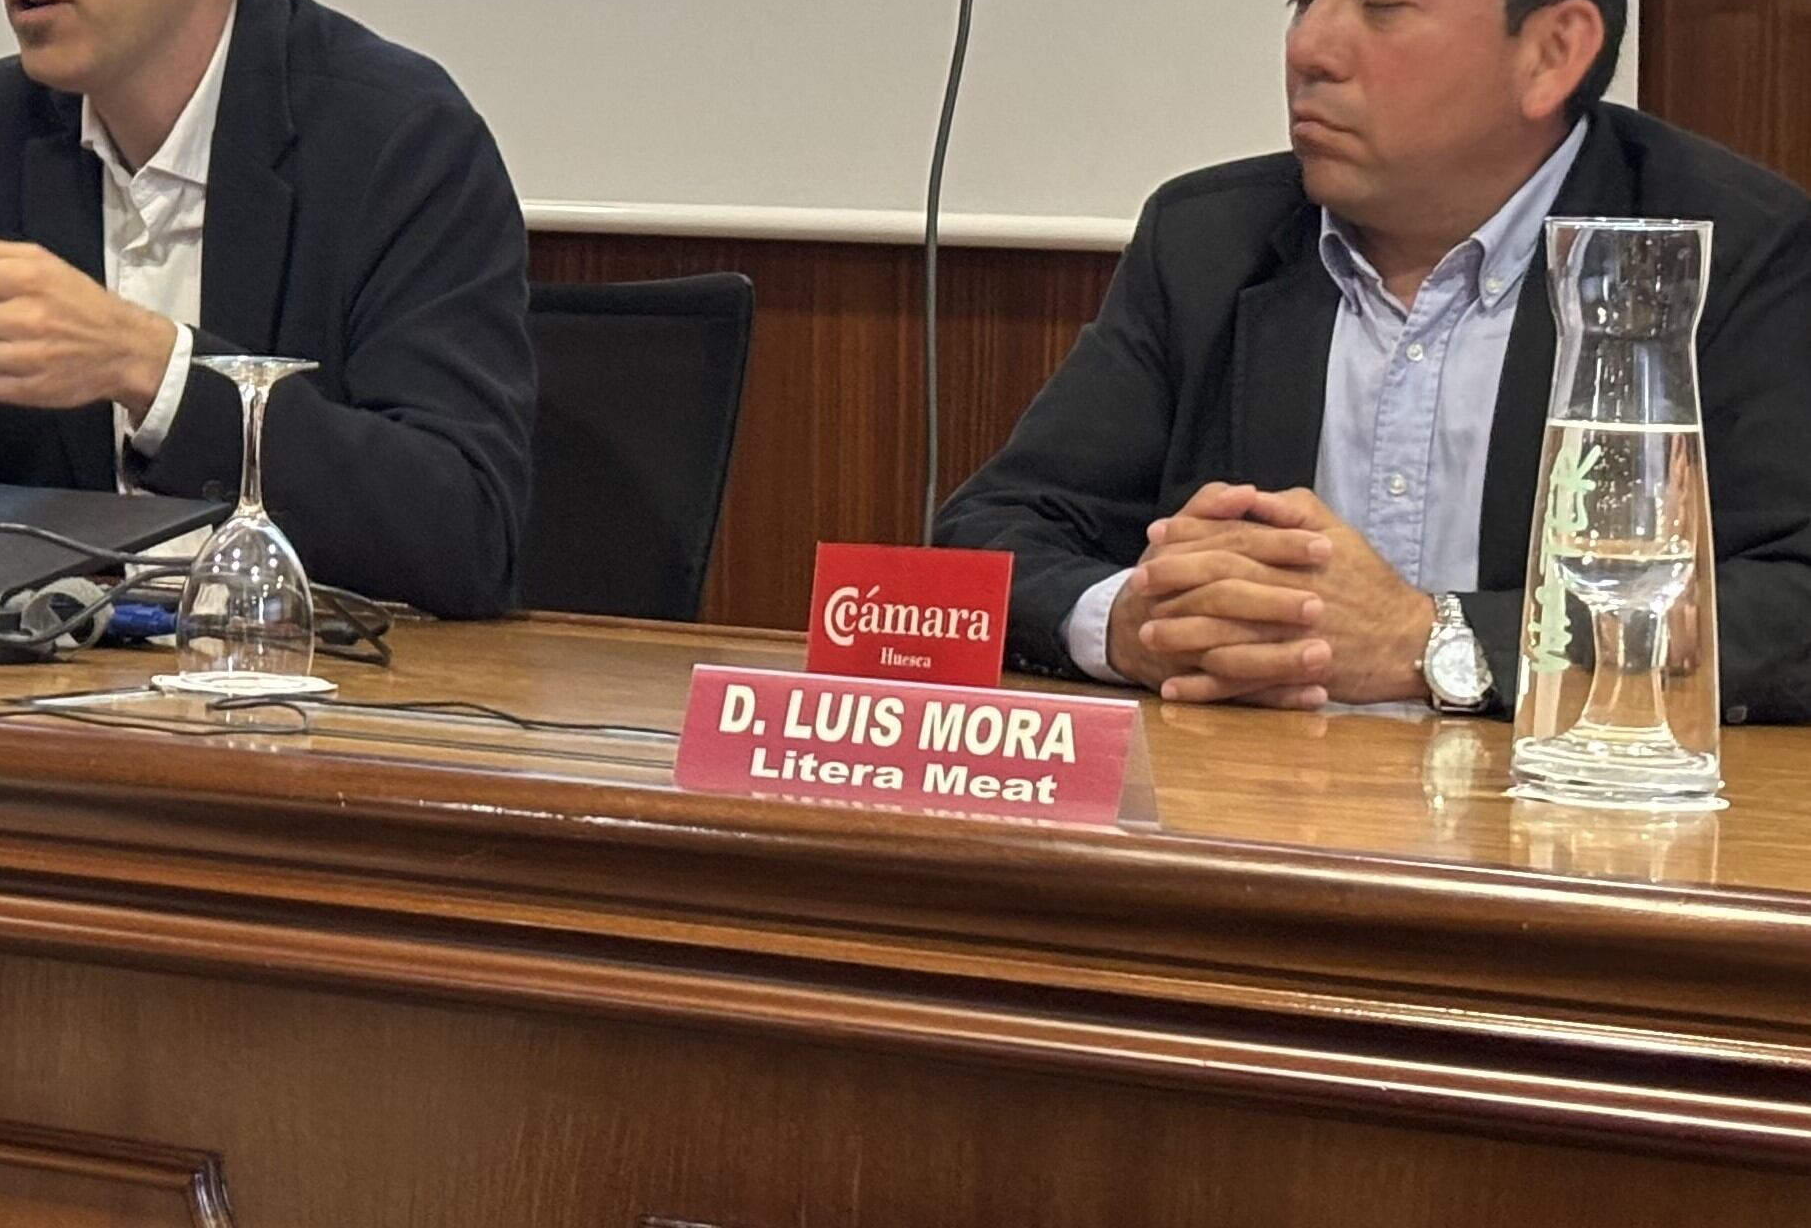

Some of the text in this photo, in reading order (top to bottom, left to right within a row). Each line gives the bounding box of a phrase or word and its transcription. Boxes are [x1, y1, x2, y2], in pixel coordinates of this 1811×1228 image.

[880, 647, 932, 669] Huesca
[719, 684, 1076, 764] D. LUIS MORA
[750, 748, 1058, 805] Litera Meat
